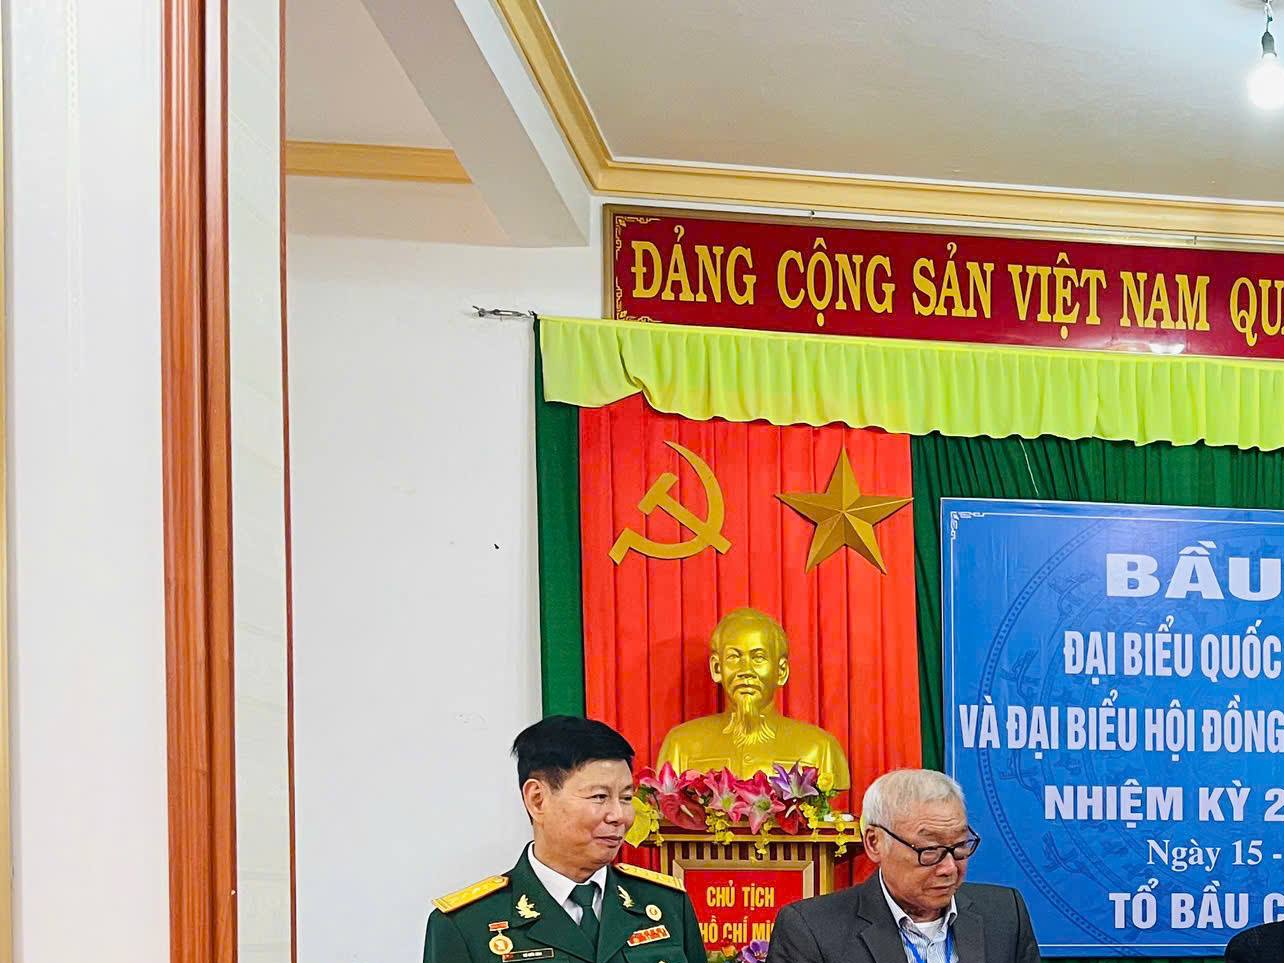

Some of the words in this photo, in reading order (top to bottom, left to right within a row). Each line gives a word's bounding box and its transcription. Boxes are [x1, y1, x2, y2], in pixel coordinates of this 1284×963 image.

[630, 225, 757, 305] ĐẢNG
[777, 237, 894, 327] CỘNG
[912, 241, 993, 319] SẢN
[1009, 252, 1106, 340] VIỆT
[1119, 270, 1211, 332] NAM
[1106, 540, 1281, 601] BẦU
[1063, 630, 1116, 685] ĐẠI
[1123, 615, 1194, 678] BIỂU
[1200, 619, 1282, 683] QUỐC
[958, 694, 1001, 749] VÀ
[1006, 705, 1060, 760] ĐẠI
[1067, 688, 1138, 751] BIỂU
[1144, 698, 1196, 762] HỘI
[1044, 778, 1184, 828] NHIỆM
[1199, 779, 1251, 822] KỲ
[1146, 838, 1221, 872] Ngày
[1231, 839, 1263, 865] 15
[706, 880, 735, 907] CHỦ
[742, 883, 775, 911] TỊCH
[1108, 877, 1159, 929] TỔ
[1170, 880, 1249, 929] BẦU
[723, 916, 748, 943] CHÍ
